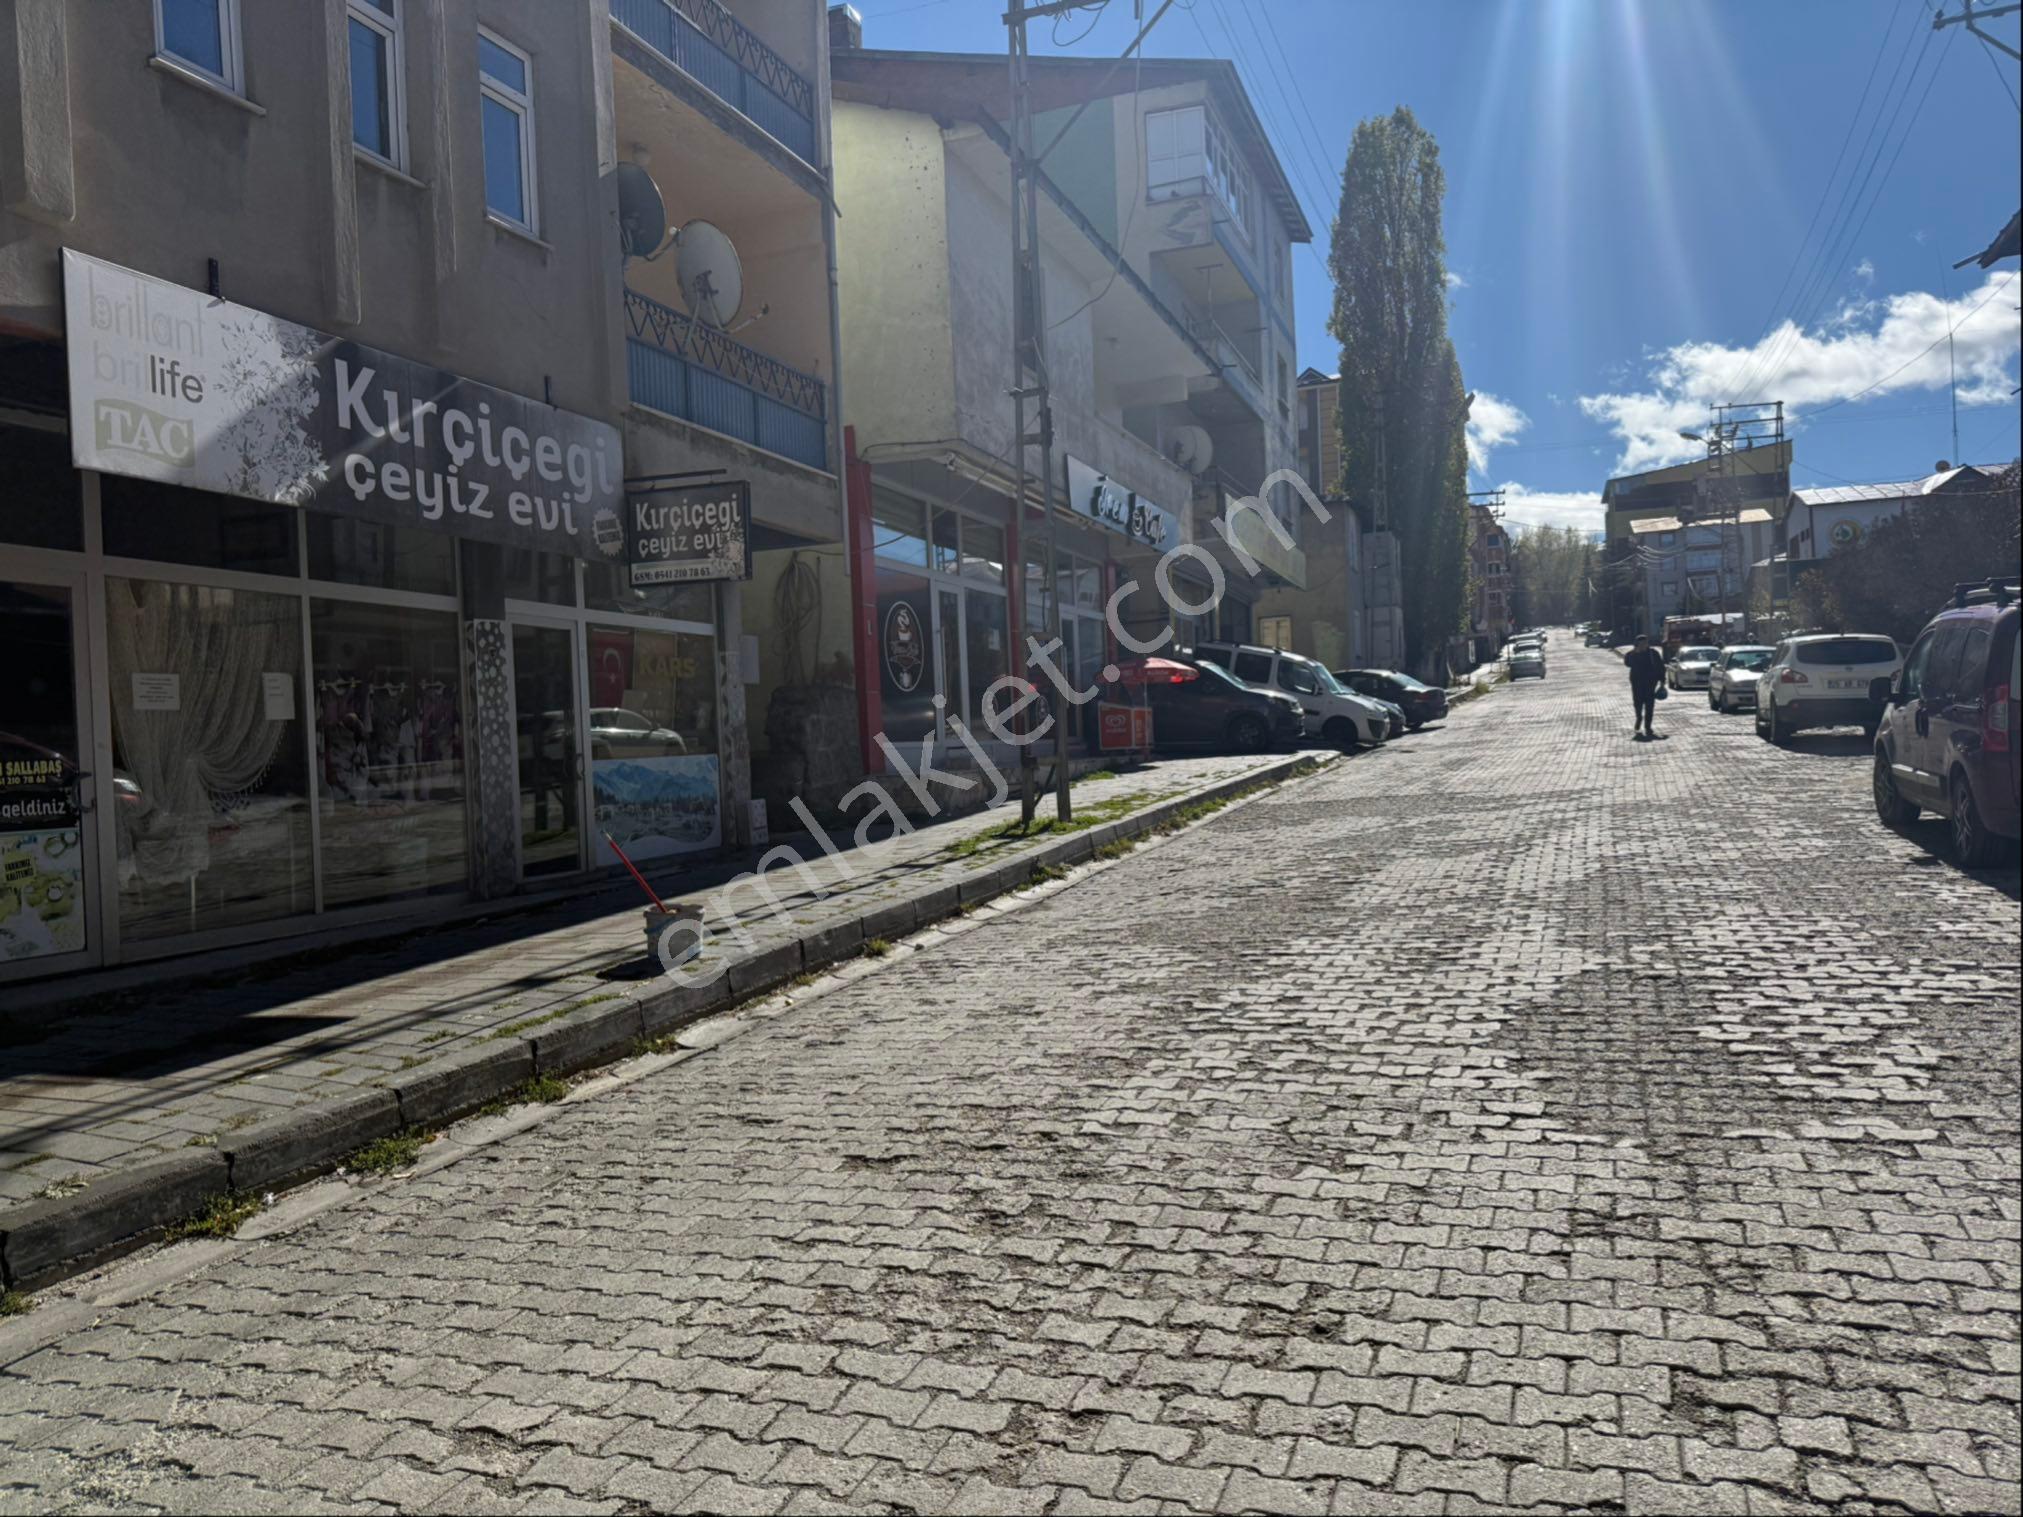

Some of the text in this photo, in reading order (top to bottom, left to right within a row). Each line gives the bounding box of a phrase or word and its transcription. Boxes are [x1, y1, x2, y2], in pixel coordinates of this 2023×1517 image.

[87, 264, 206, 359] brillant
[98, 405, 190, 459] TAC
[333, 357, 615, 505] Kırçiçegi
[343, 452, 578, 536] çeyiz evi
[635, 493, 741, 532] Kırçiçegi
[637, 531, 689, 559] çeyiz
[693, 527, 723, 551] evi
[673, 568, 688, 578] 210
[688, 567, 699, 576] 78
[639, 655, 697, 680] KARS
[6, 759, 63, 778] SALLABAŞ
[7, 776, 22, 786] 210
[1, 797, 66, 818] geldiniz
